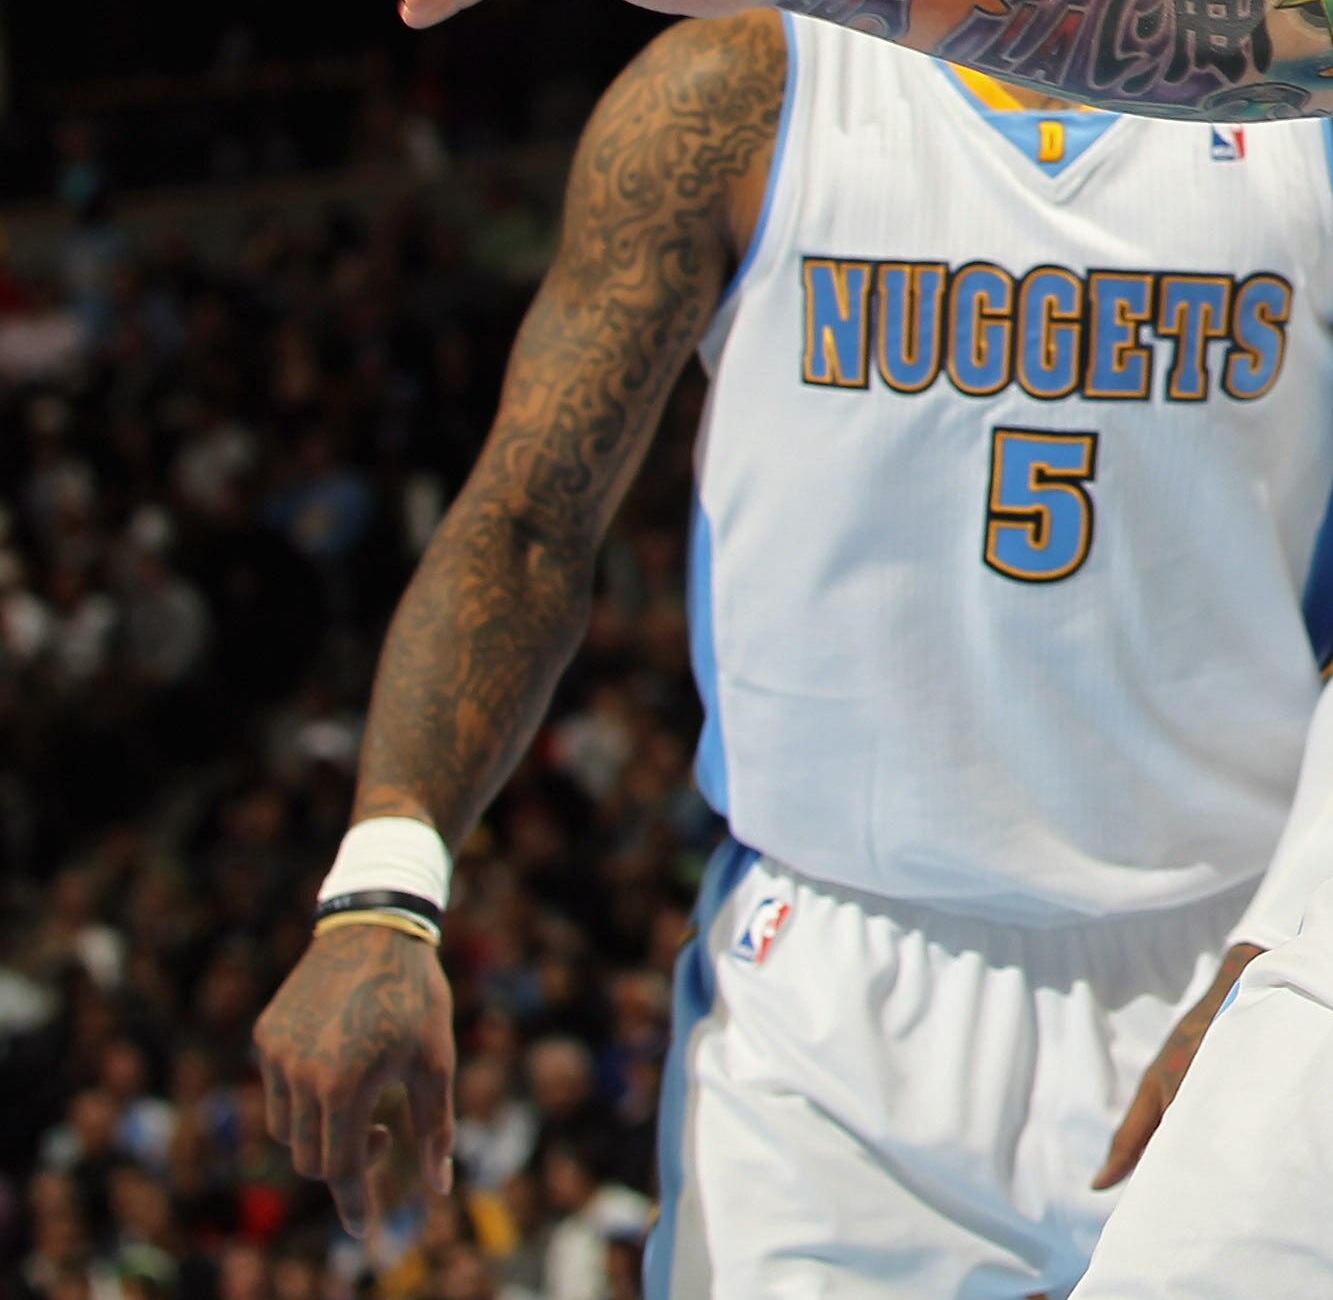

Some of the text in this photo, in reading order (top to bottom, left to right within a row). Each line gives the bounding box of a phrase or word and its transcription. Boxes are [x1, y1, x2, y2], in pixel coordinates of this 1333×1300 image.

[1037, 120, 1065, 163] D
[801, 256, 1293, 402] NUGGETS
[983, 427, 1101, 584] 5
